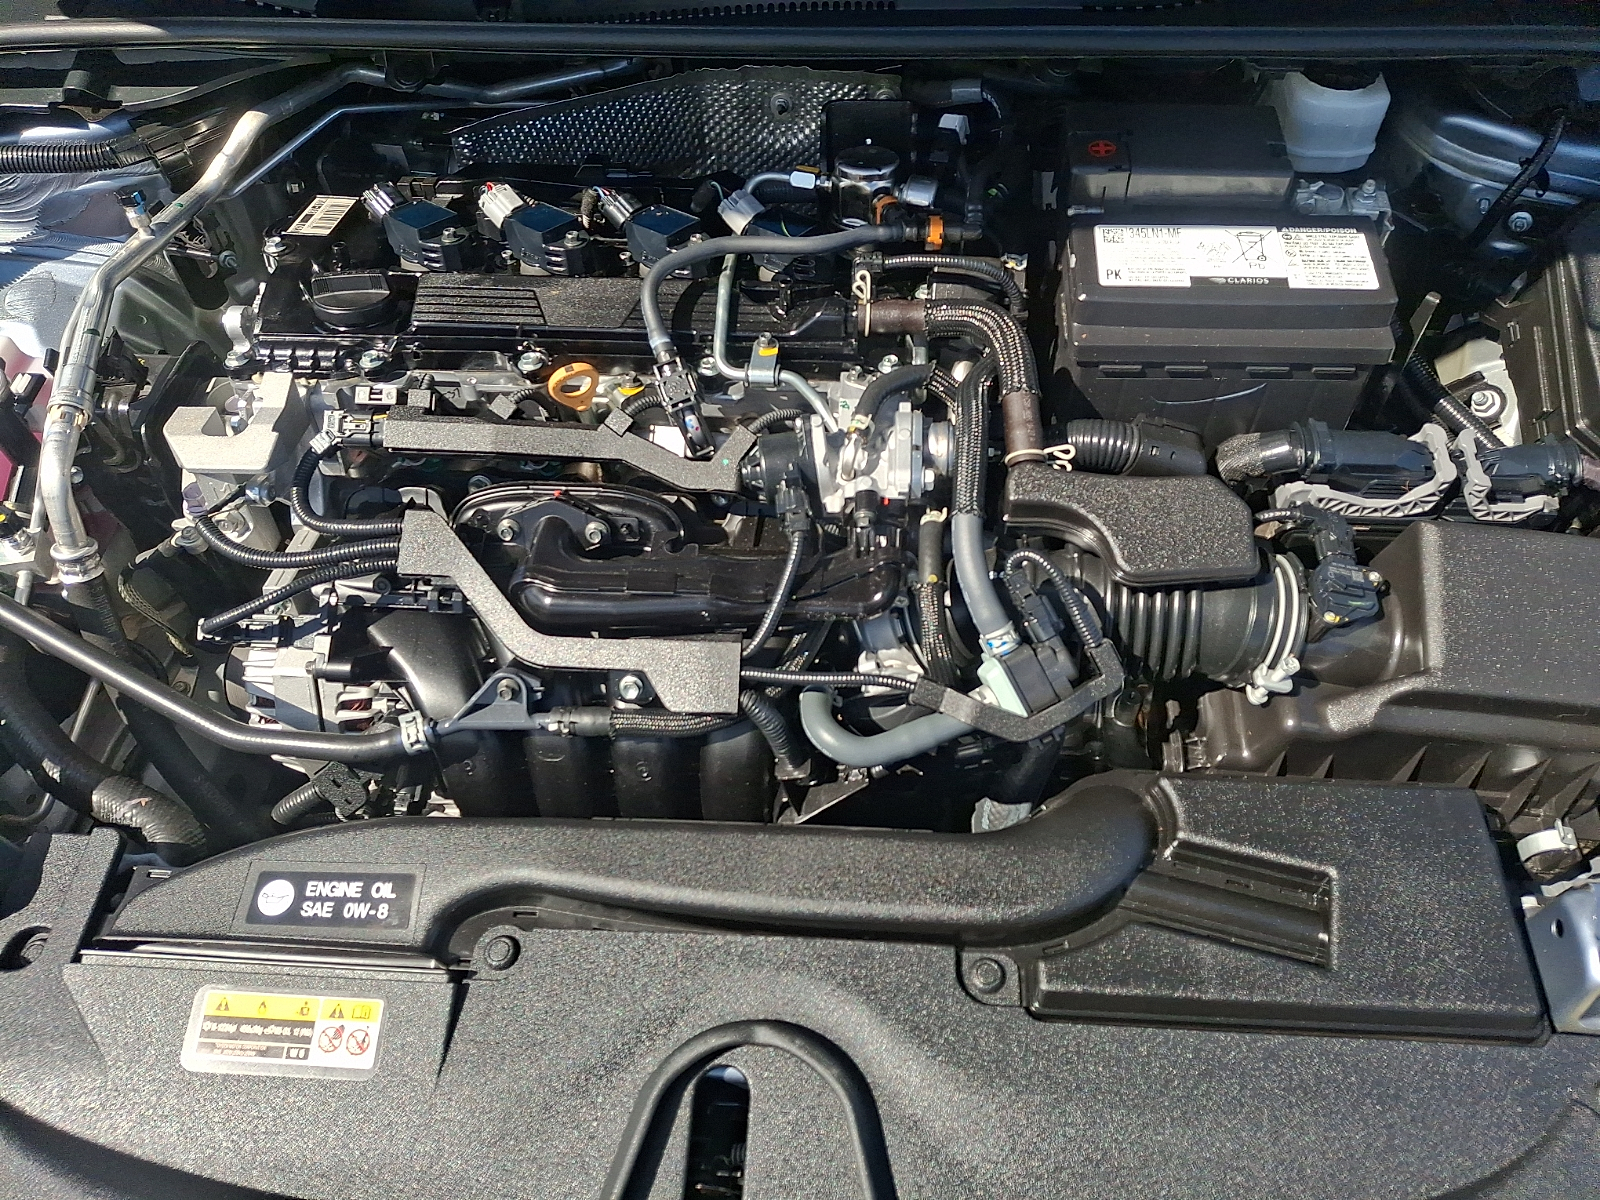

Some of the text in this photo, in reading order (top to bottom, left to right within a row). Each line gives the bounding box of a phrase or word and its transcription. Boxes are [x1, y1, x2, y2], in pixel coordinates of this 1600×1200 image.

[1106, 269, 1122, 280] PK
[1227, 277, 1270, 285] CLARIOS
[305, 880, 397, 899] ENGINE OIL
[300, 901, 389, 920] SAE 0W-8
